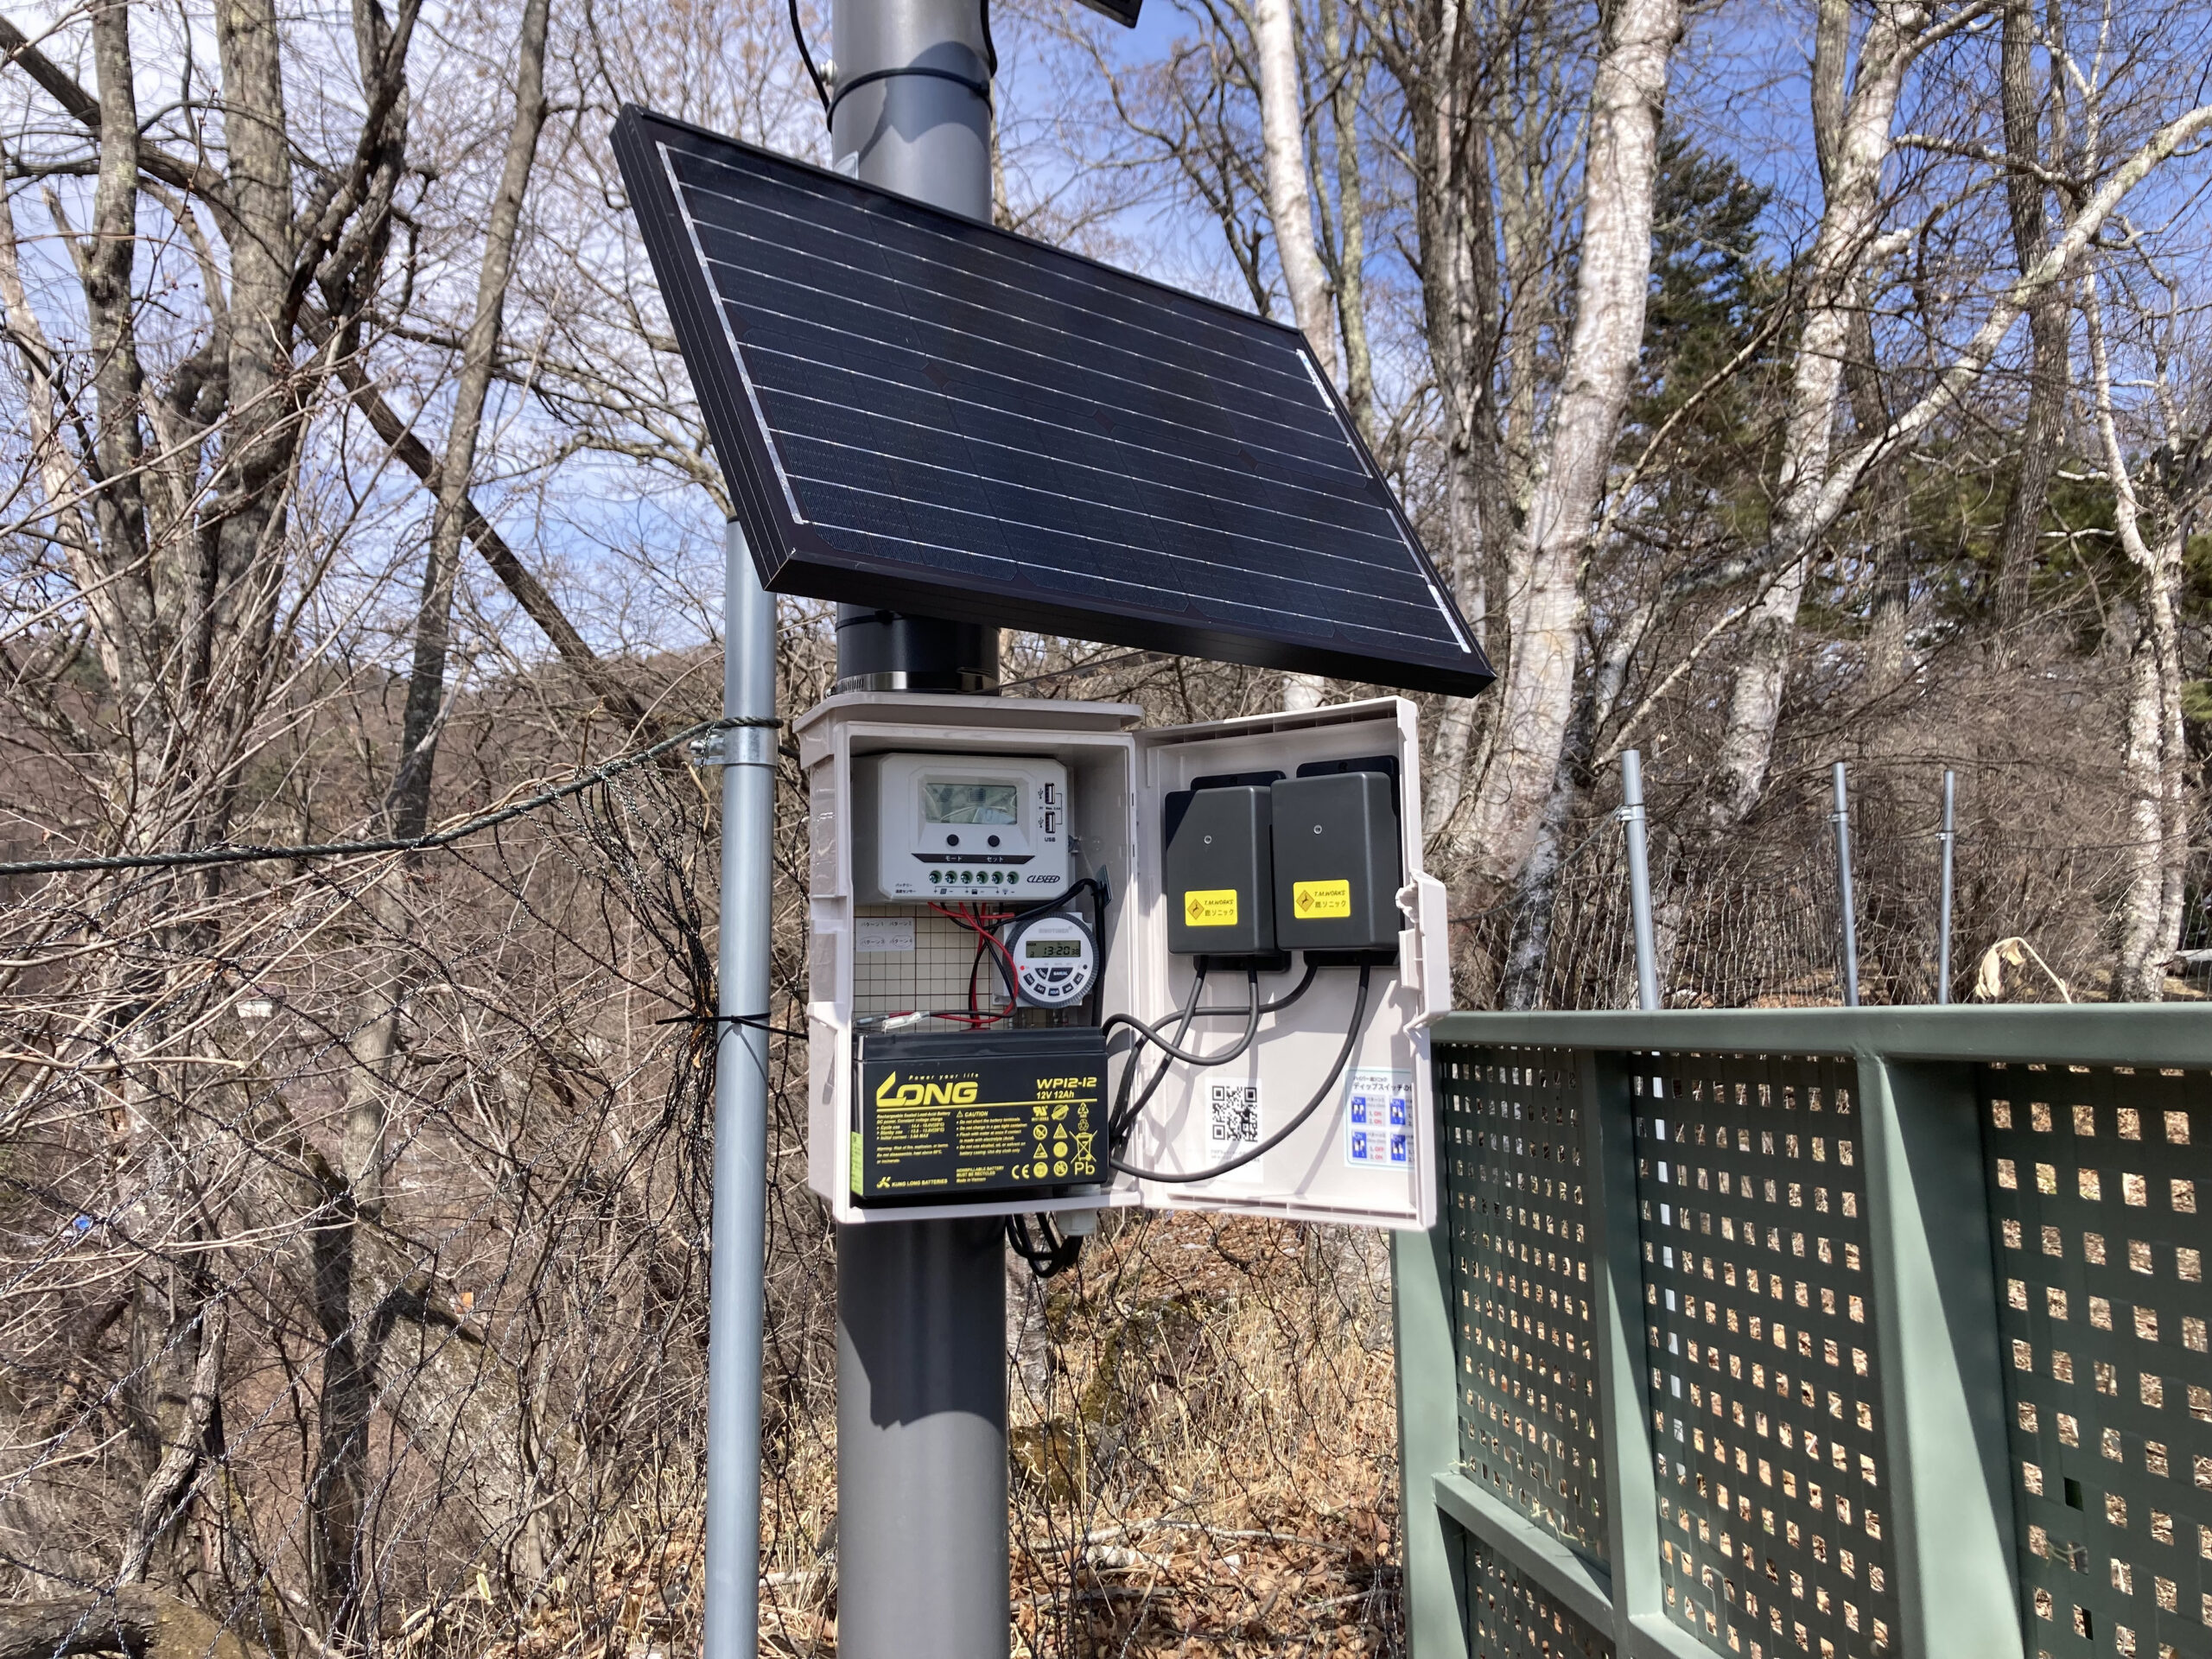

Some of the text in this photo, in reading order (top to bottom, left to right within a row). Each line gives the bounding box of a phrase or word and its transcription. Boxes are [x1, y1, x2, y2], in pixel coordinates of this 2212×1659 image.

[1027, 874, 1061, 883] CLESEED
[1044, 946, 1071, 956] 13:20
[876, 1071, 978, 1107] LONG
[1037, 1077, 1097, 1090] WP12-12
[1037, 1090, 1074, 1099] 12V 12Ah
[1074, 1161, 1096, 1175] Pb
